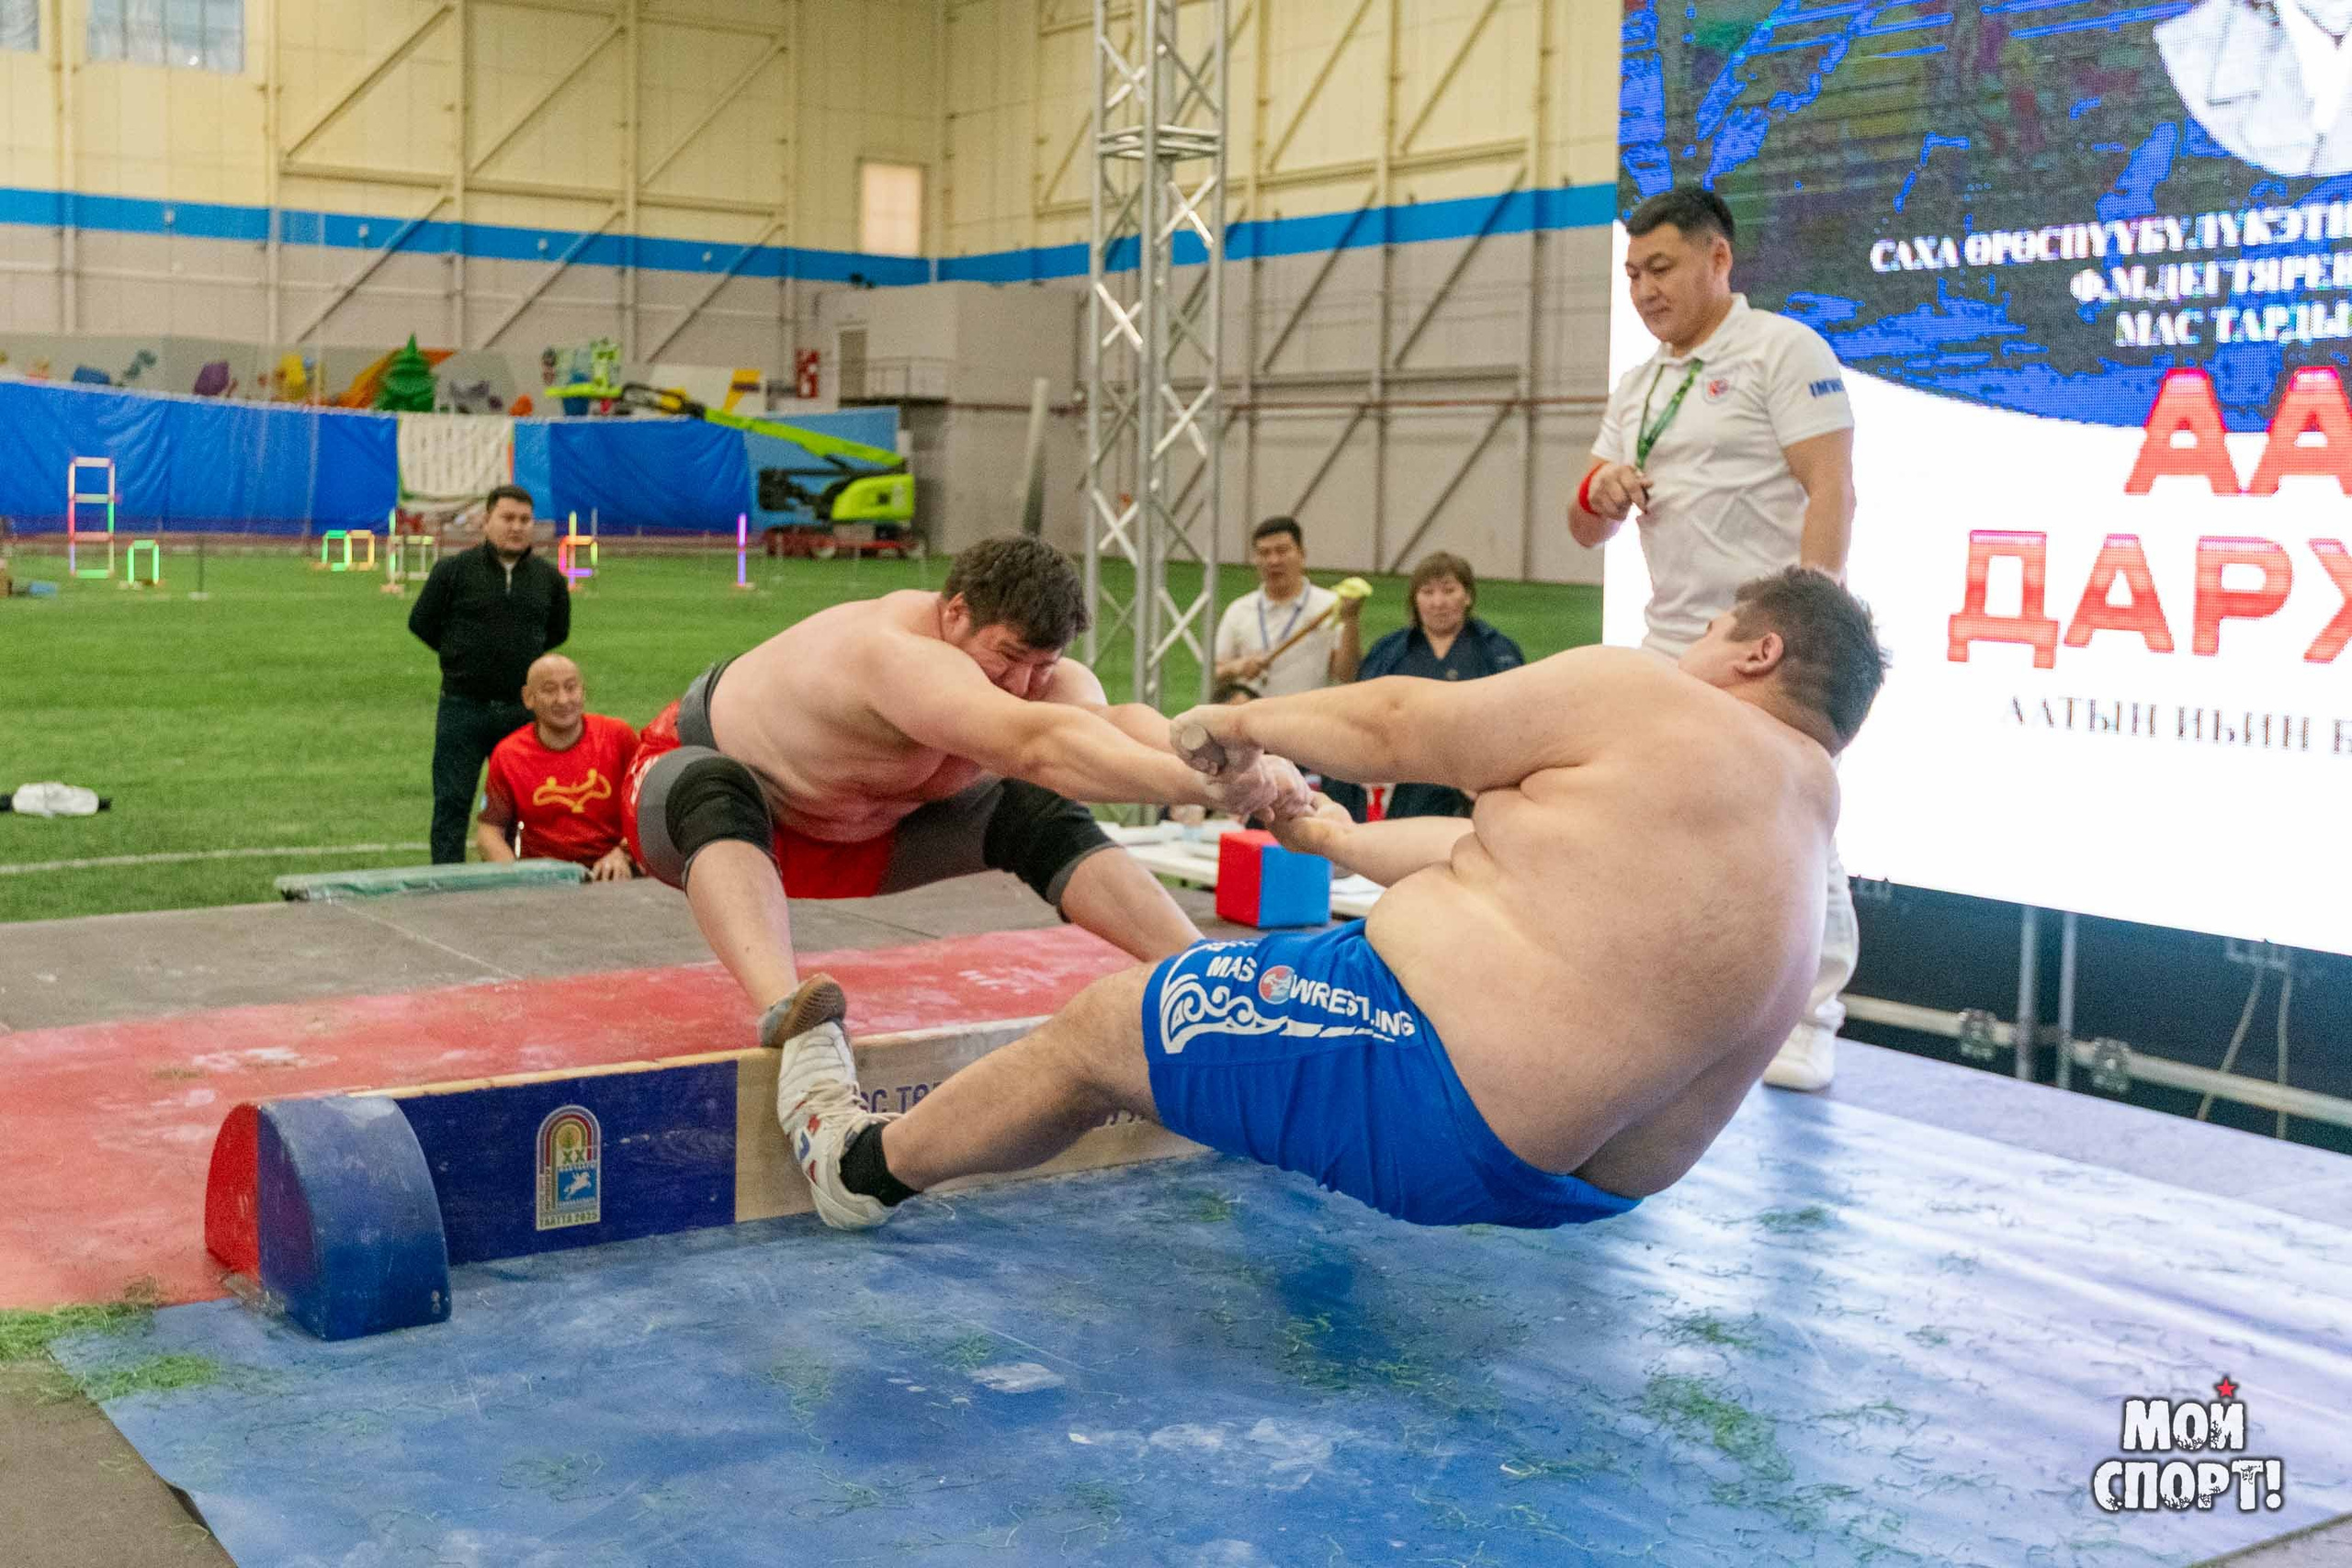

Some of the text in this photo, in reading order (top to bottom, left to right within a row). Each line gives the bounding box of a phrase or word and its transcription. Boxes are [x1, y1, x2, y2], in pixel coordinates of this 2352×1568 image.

[1870, 235, 1962, 273] САХА
[2115, 310, 2205, 347] МАС
[1206, 955, 1416, 1037] MAS WRESTING
